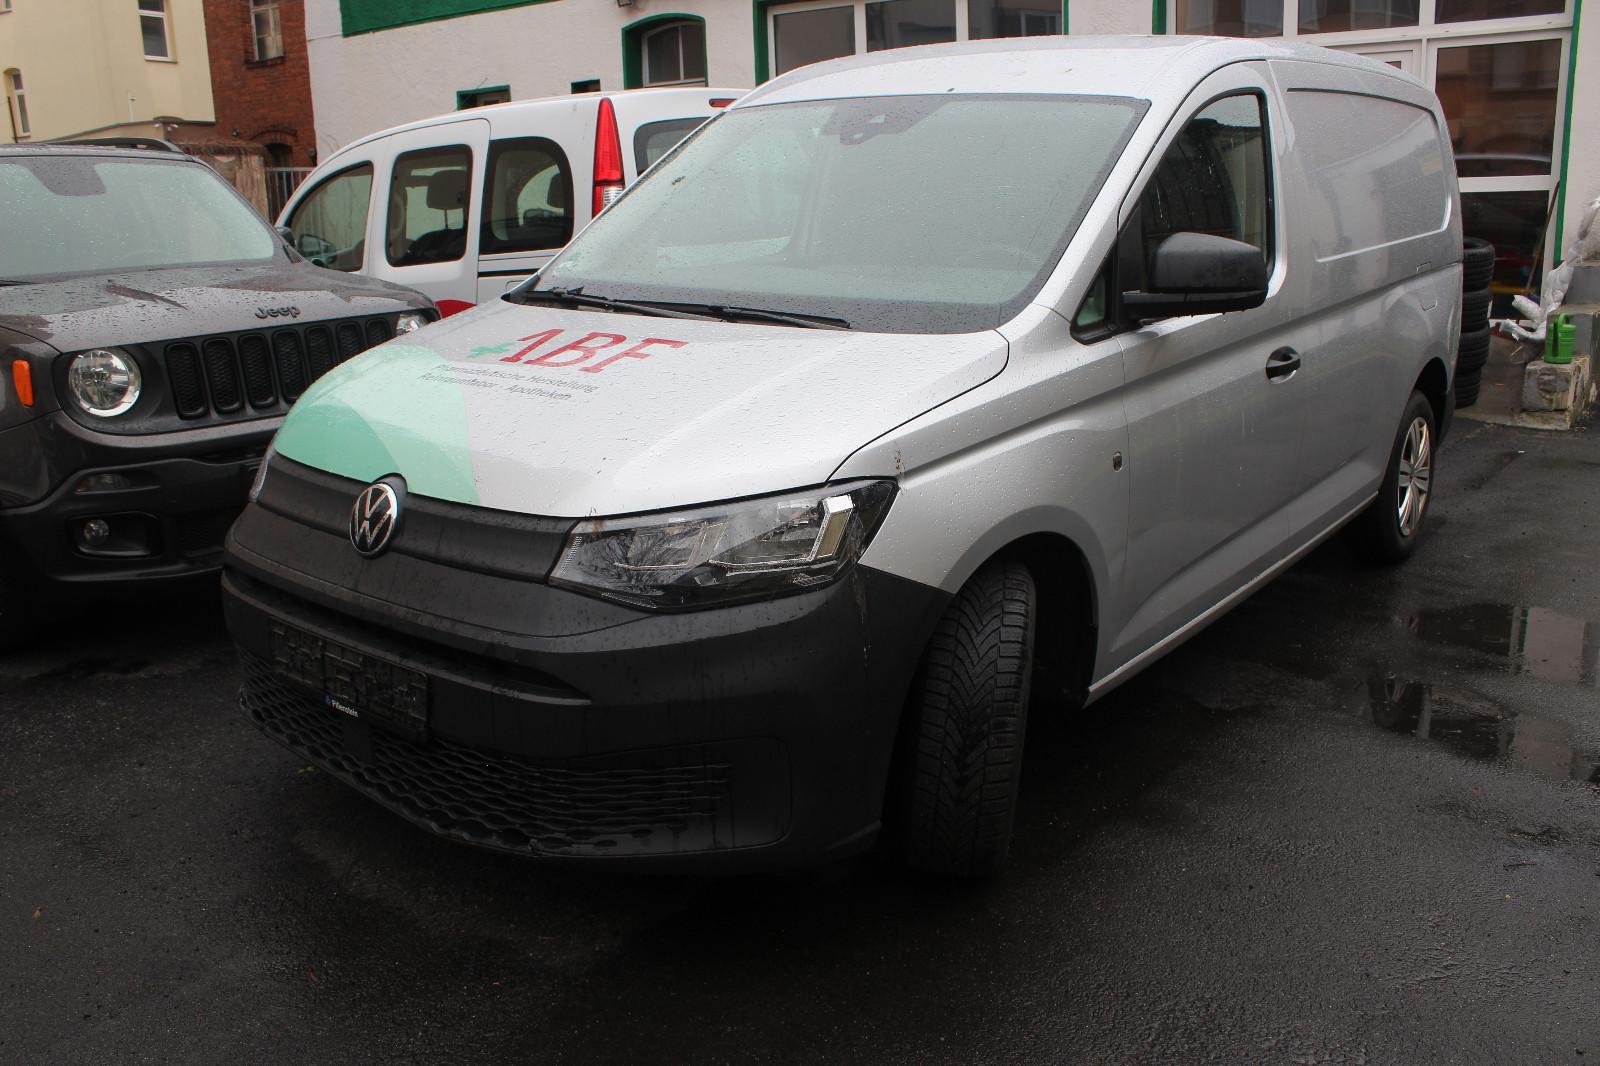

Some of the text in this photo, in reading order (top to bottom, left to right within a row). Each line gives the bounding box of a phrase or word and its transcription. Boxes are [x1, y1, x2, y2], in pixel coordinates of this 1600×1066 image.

[254, 305, 301, 319] Jeep
[504, 384, 573, 401] Apotheken
[525, 375, 600, 394] Herstellung
